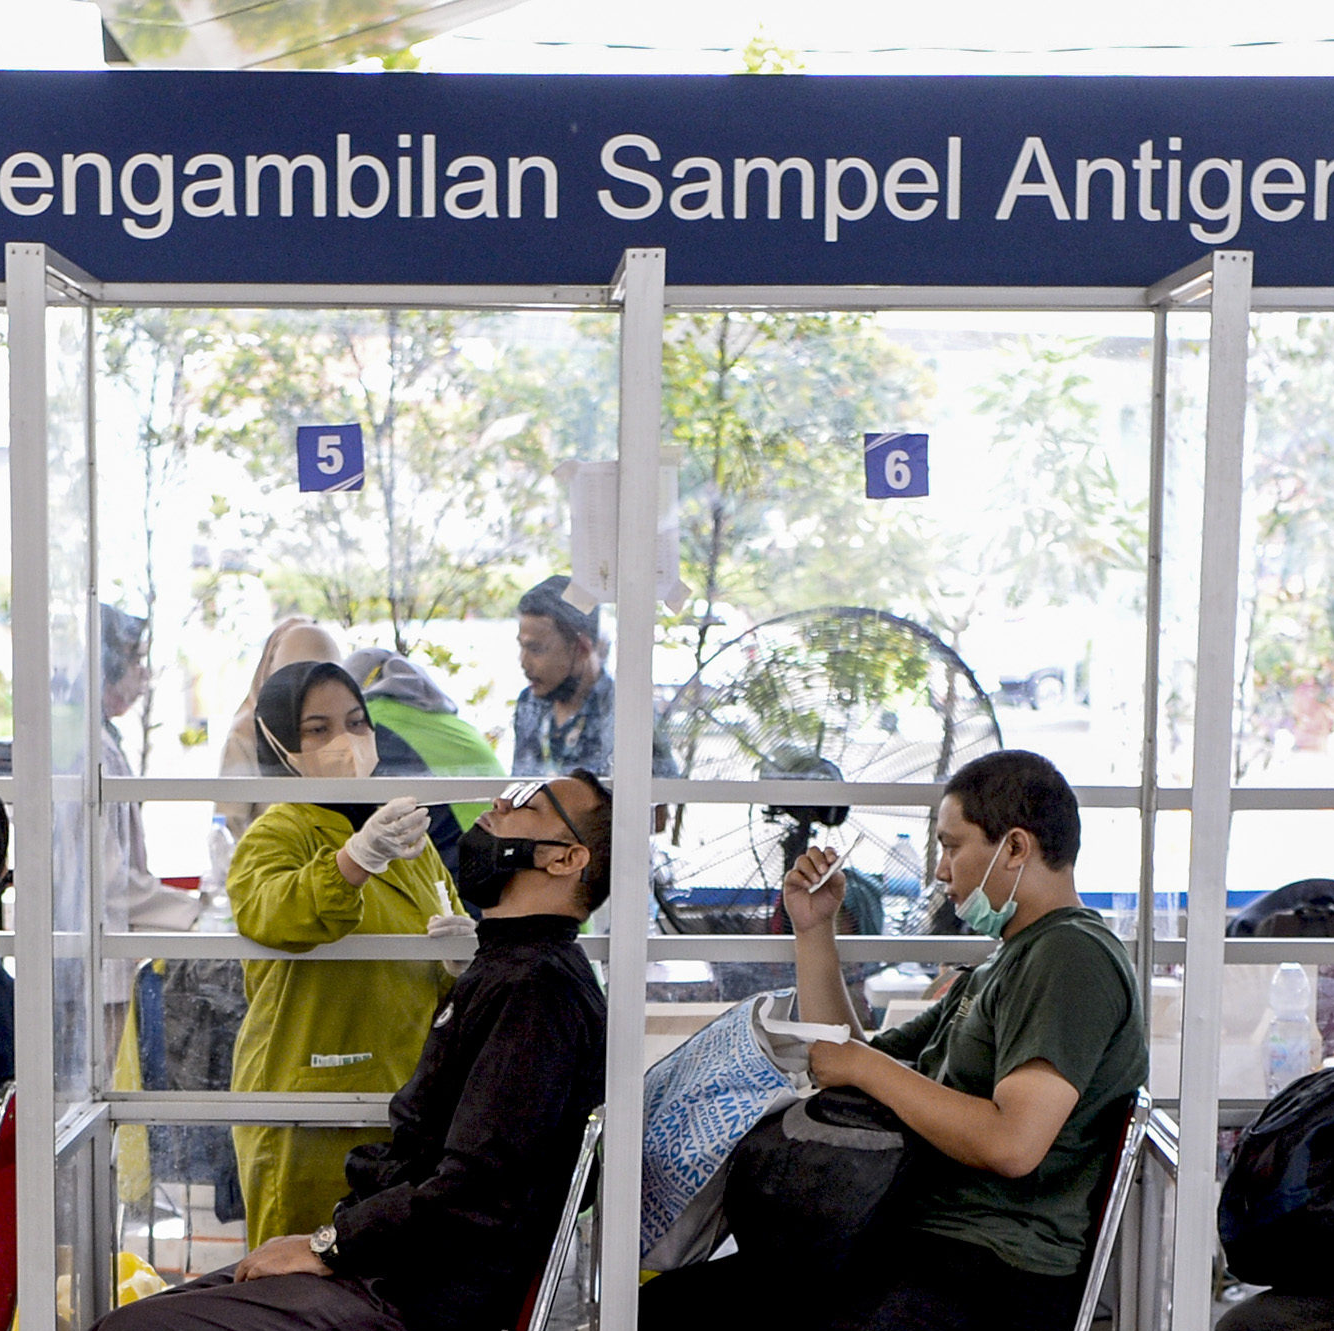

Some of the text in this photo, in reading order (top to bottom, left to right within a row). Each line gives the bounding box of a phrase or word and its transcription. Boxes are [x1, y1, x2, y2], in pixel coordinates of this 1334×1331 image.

[596, 133, 963, 242] Sampel
[317, 435, 344, 475] 5
[884, 449, 911, 490] 6
